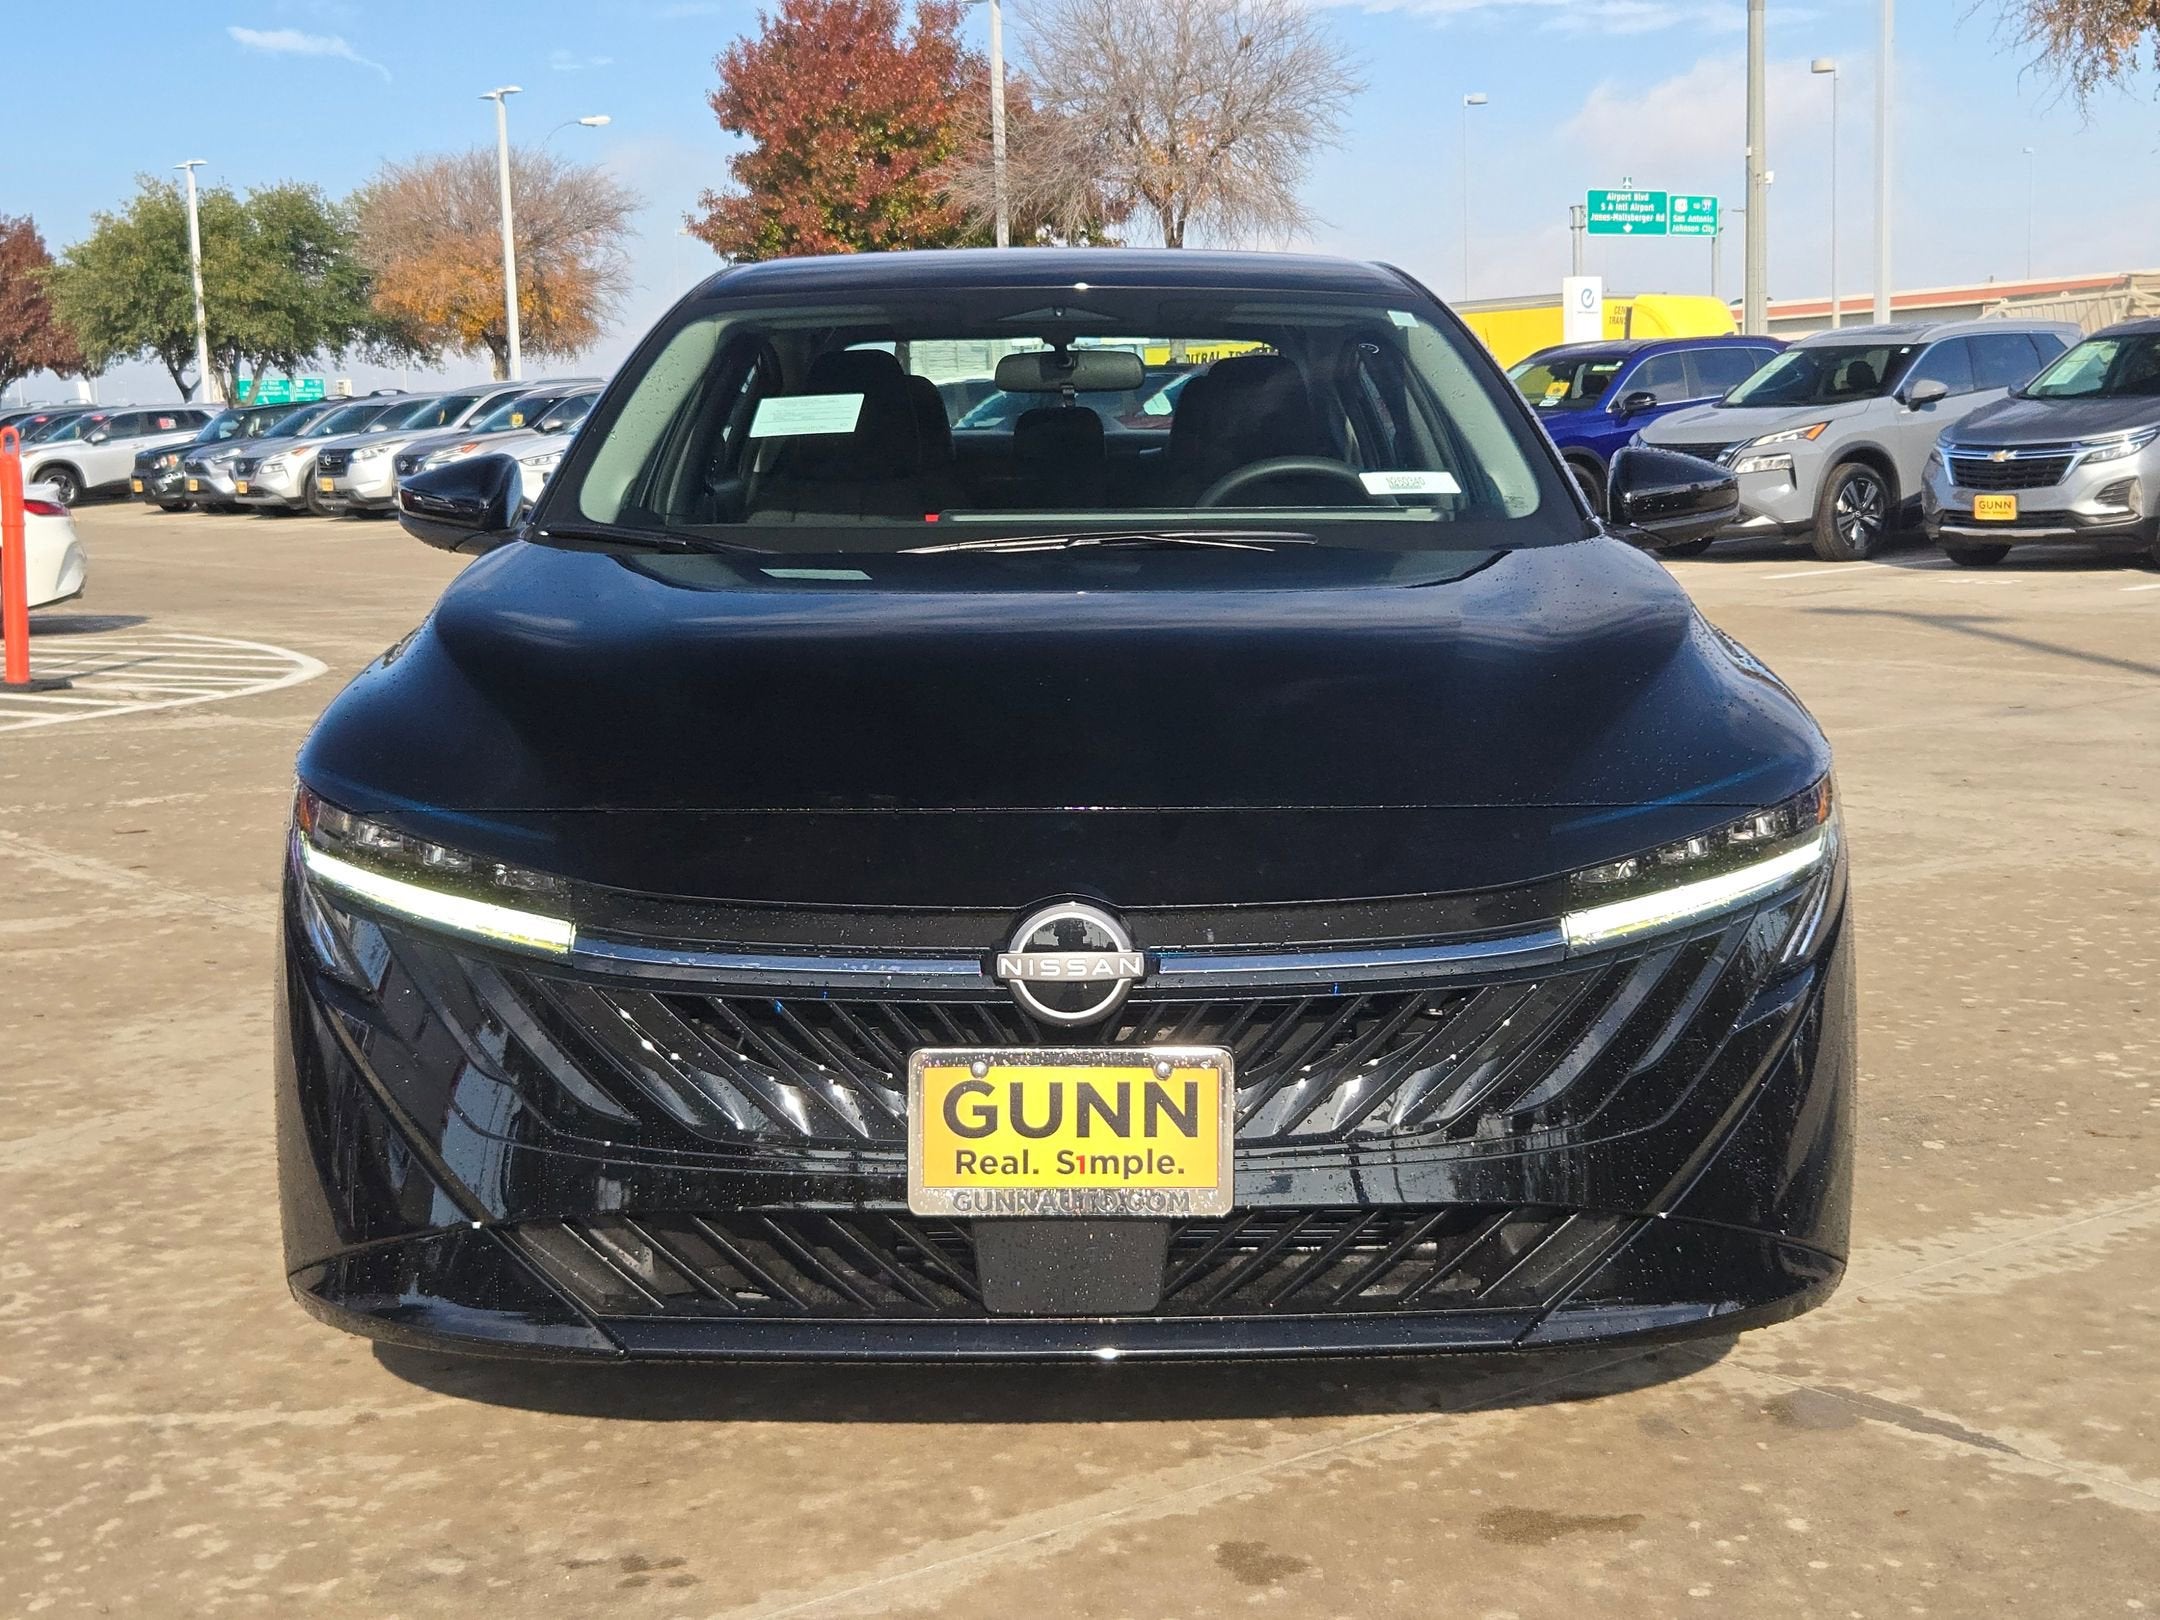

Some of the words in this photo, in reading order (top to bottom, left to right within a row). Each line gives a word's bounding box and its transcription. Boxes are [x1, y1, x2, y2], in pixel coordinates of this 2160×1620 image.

[1606, 192, 1632, 202] Airport
[1633, 192, 1649, 202] Blvd
[1629, 203, 1655, 213] Airport
[1978, 500, 2012, 510] GUNN
[1000, 957, 1142, 977] NISSAN
[942, 1080, 1199, 1140] GUNN
[955, 1149, 1039, 1176] Real.
[952, 1191, 1190, 1213] GUNNAUTO.COM
